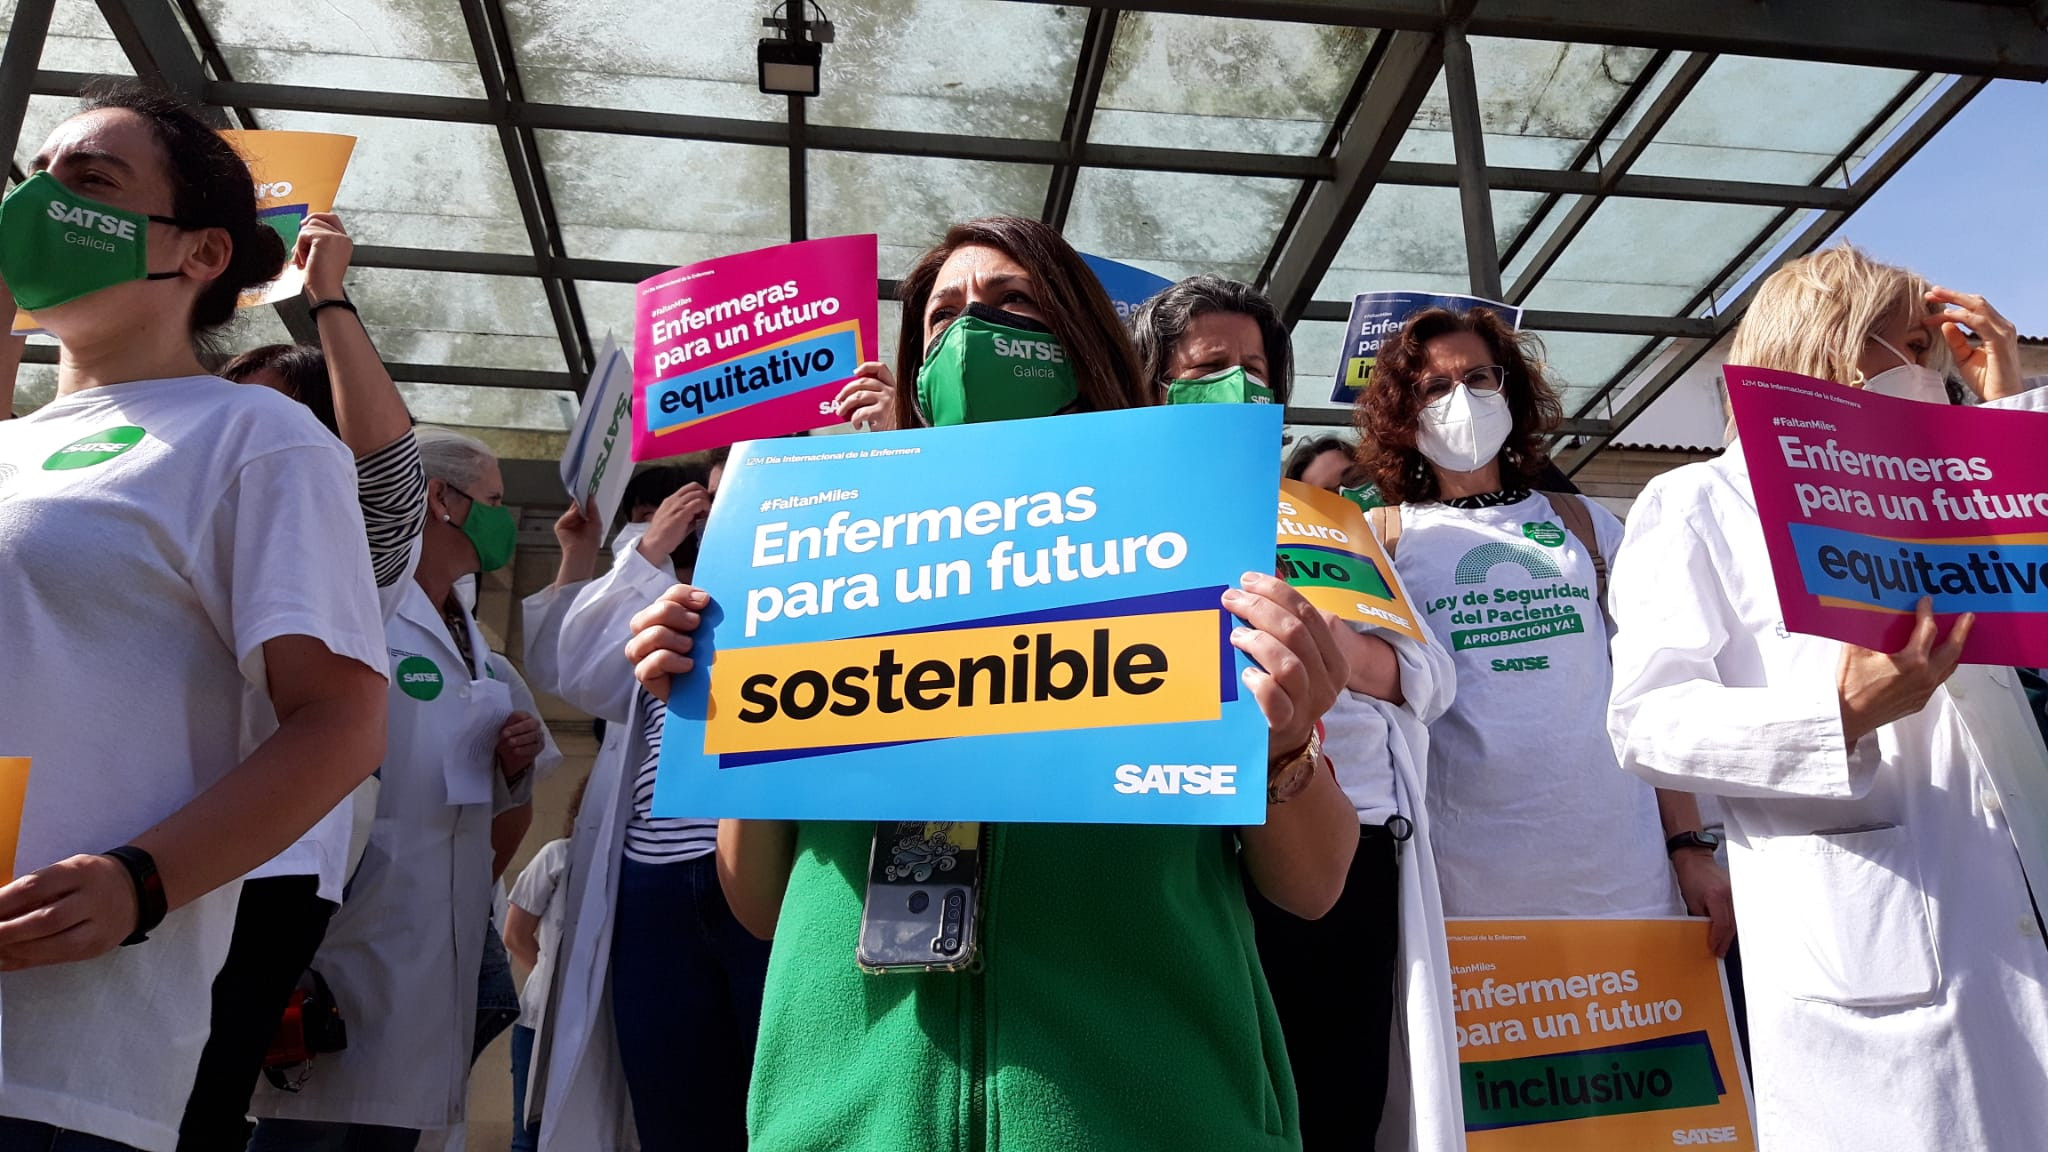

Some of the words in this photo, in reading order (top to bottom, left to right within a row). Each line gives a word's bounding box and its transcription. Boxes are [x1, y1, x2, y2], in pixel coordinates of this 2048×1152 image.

[47, 200, 137, 241] SATSE
[64, 231, 115, 253] Galicia
[652, 280, 798, 346] Enfermeras
[1360, 319, 1405, 335] Enfer
[654, 342, 711, 377] para
[715, 321, 749, 350] un
[753, 297, 839, 337] futuro
[994, 338, 1064, 364] SATSE
[659, 347, 834, 415] equitativo
[1012, 365, 1055, 379] Galicia
[1773, 417, 1837, 432] #FaltanMiles
[765, 455, 781, 464] Día
[783, 451, 844, 463] Internacional
[845, 450, 858, 458] de
[860, 449, 869, 457] la
[870, 447, 921, 457] Enfermera
[1778, 435, 1993, 481] Enfermeras
[760, 488, 859, 513] #FaltanMiles
[1794, 482, 1875, 517] para
[1881, 494, 1928, 521] un
[1932, 488, 2048, 521] futuro
[751, 485, 1097, 568] Enfermeras
[1277, 517, 1349, 544] turo
[744, 574, 879, 638] para
[894, 560, 970, 605] un
[985, 531, 1188, 591] futuro
[1426, 595, 1458, 615] Ley
[1462, 590, 1489, 606] de
[1493, 583, 1590, 606] Seguridad
[1356, 602, 1412, 631] SATSE
[1451, 610, 1482, 625] del
[1487, 604, 1576, 624] Paciente
[1463, 623, 1550, 646] APROBACIÓN
[1553, 618, 1576, 632] YA!
[403, 672, 439, 682] SATSE
[737, 628, 1168, 724] sostenible
[1491, 656, 1550, 672] SATSE
[1113, 763, 1237, 796] SATSE
[1450, 969, 1639, 1013] Enfermeras
[1533, 1013, 1580, 1039] un
[1586, 998, 1682, 1033] futuro
[1474, 1062, 1673, 1111] inclusivo
[1672, 1126, 1738, 1145] SATSE
